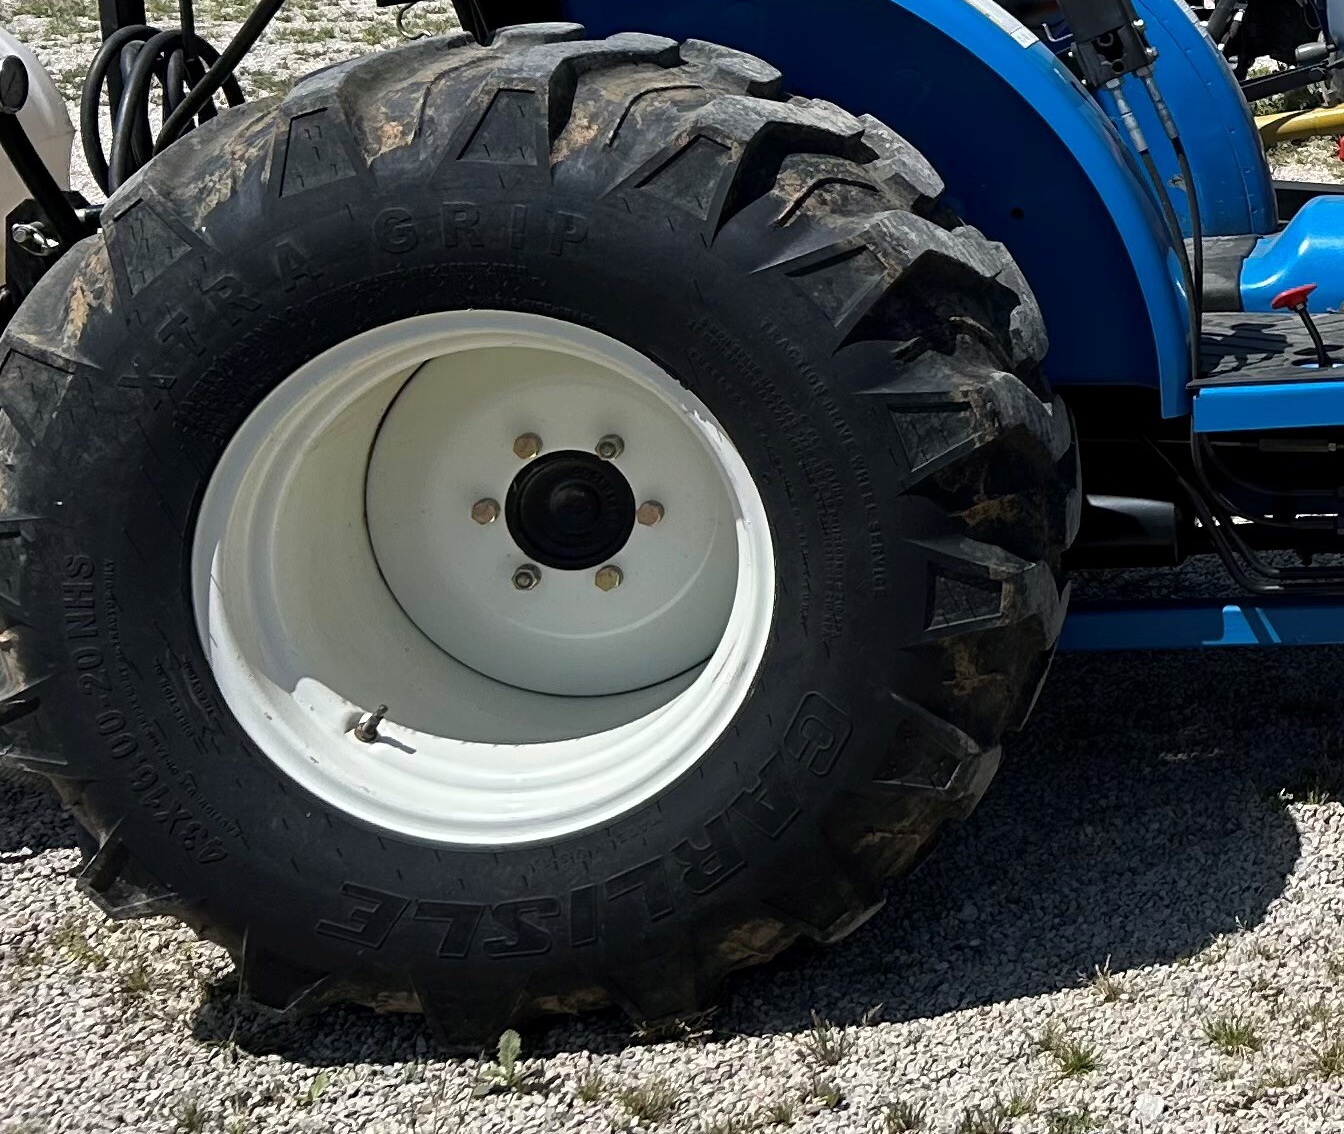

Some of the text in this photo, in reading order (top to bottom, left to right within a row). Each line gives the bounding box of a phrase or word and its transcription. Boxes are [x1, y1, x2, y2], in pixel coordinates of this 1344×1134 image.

[371, 200, 590, 256] GRIP
[62, 554, 98, 640] NHS
[314, 691, 853, 960] CARLISLE
